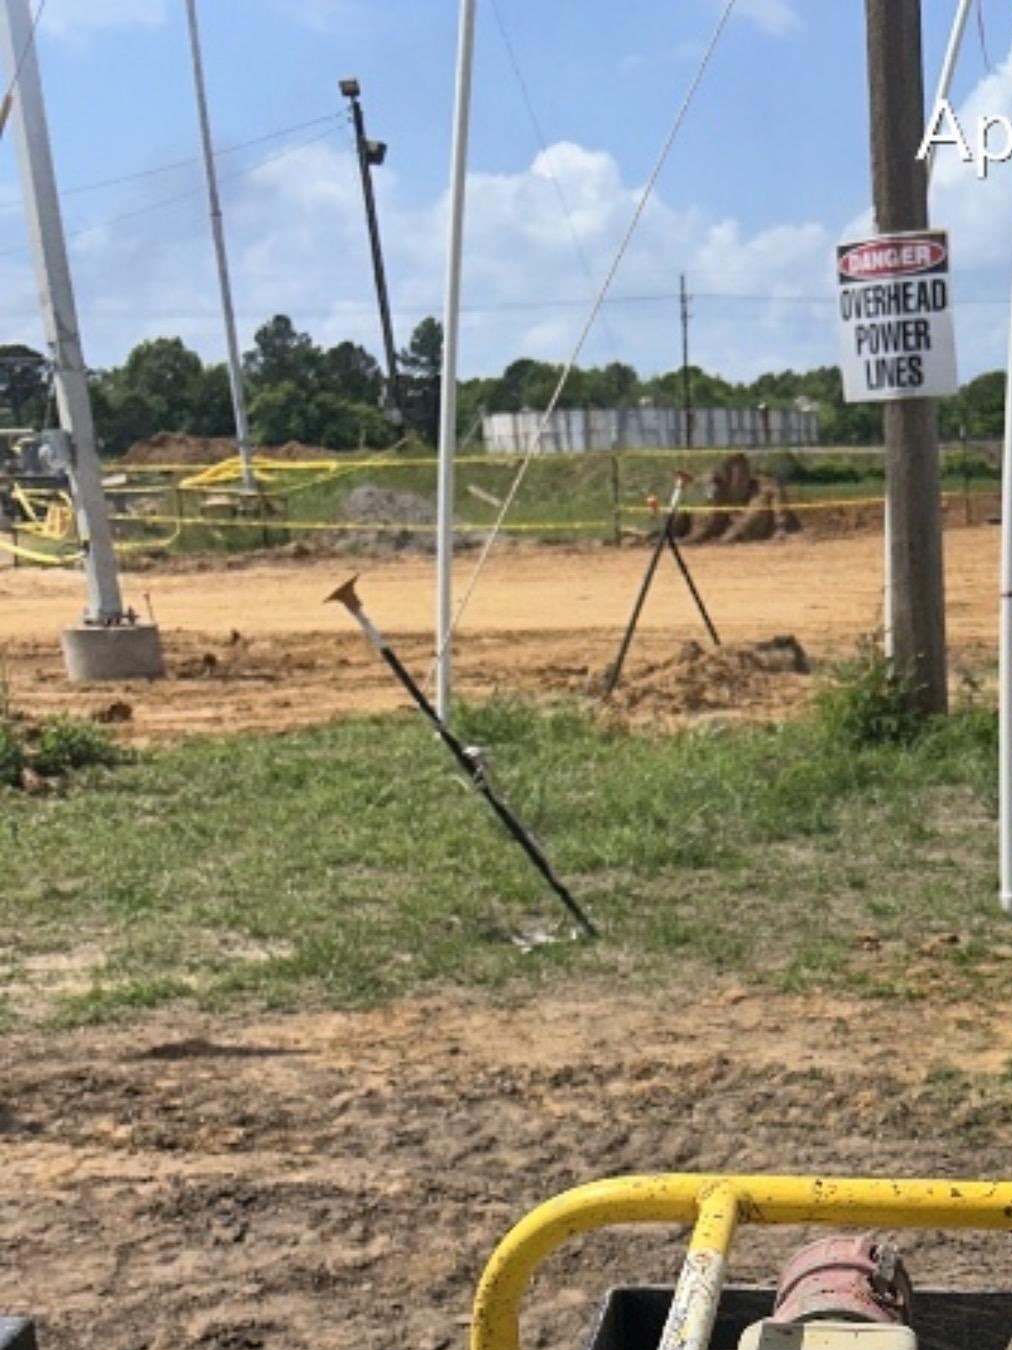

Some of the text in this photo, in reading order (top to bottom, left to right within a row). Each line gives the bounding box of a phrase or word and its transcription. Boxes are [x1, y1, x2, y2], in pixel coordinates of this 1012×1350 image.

[847, 245, 931, 272] DANGER
[840, 279, 947, 321] OVERHEAD
[855, 319, 932, 356] POWER
[865, 355, 924, 391] LINES
